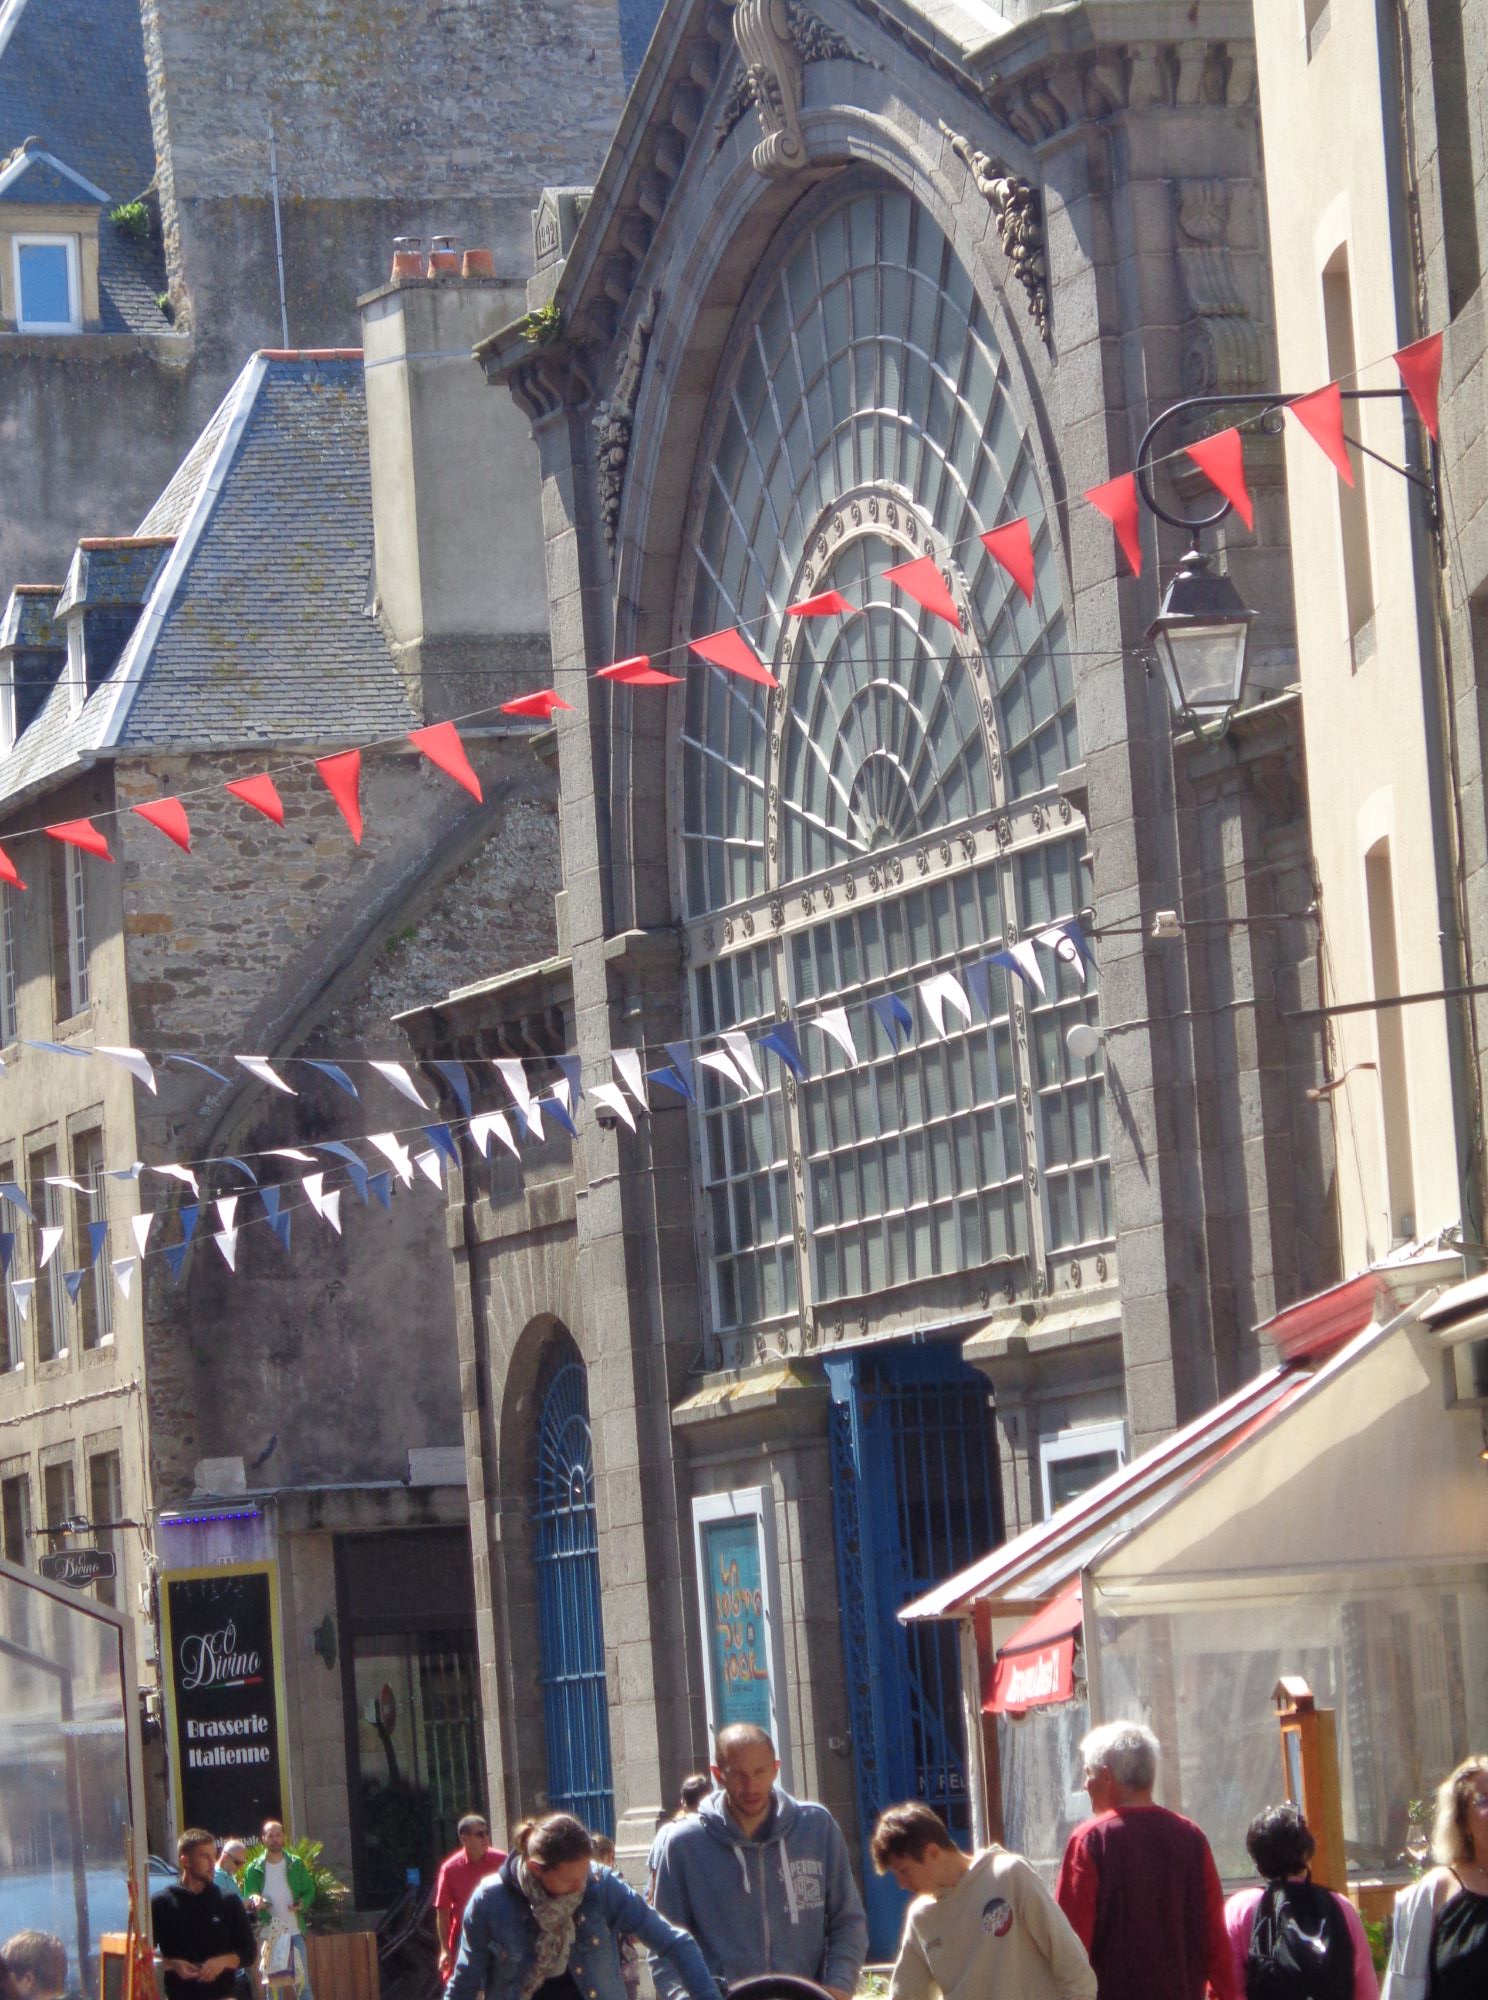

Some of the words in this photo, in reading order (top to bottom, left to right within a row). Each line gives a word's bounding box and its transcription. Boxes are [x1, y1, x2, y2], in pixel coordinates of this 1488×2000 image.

[180, 1634, 261, 1690] Divino
[187, 1714, 268, 1739] Brasserie
[188, 1746, 270, 1768] Italienne
[778, 1859, 822, 1882] SPERDRY
